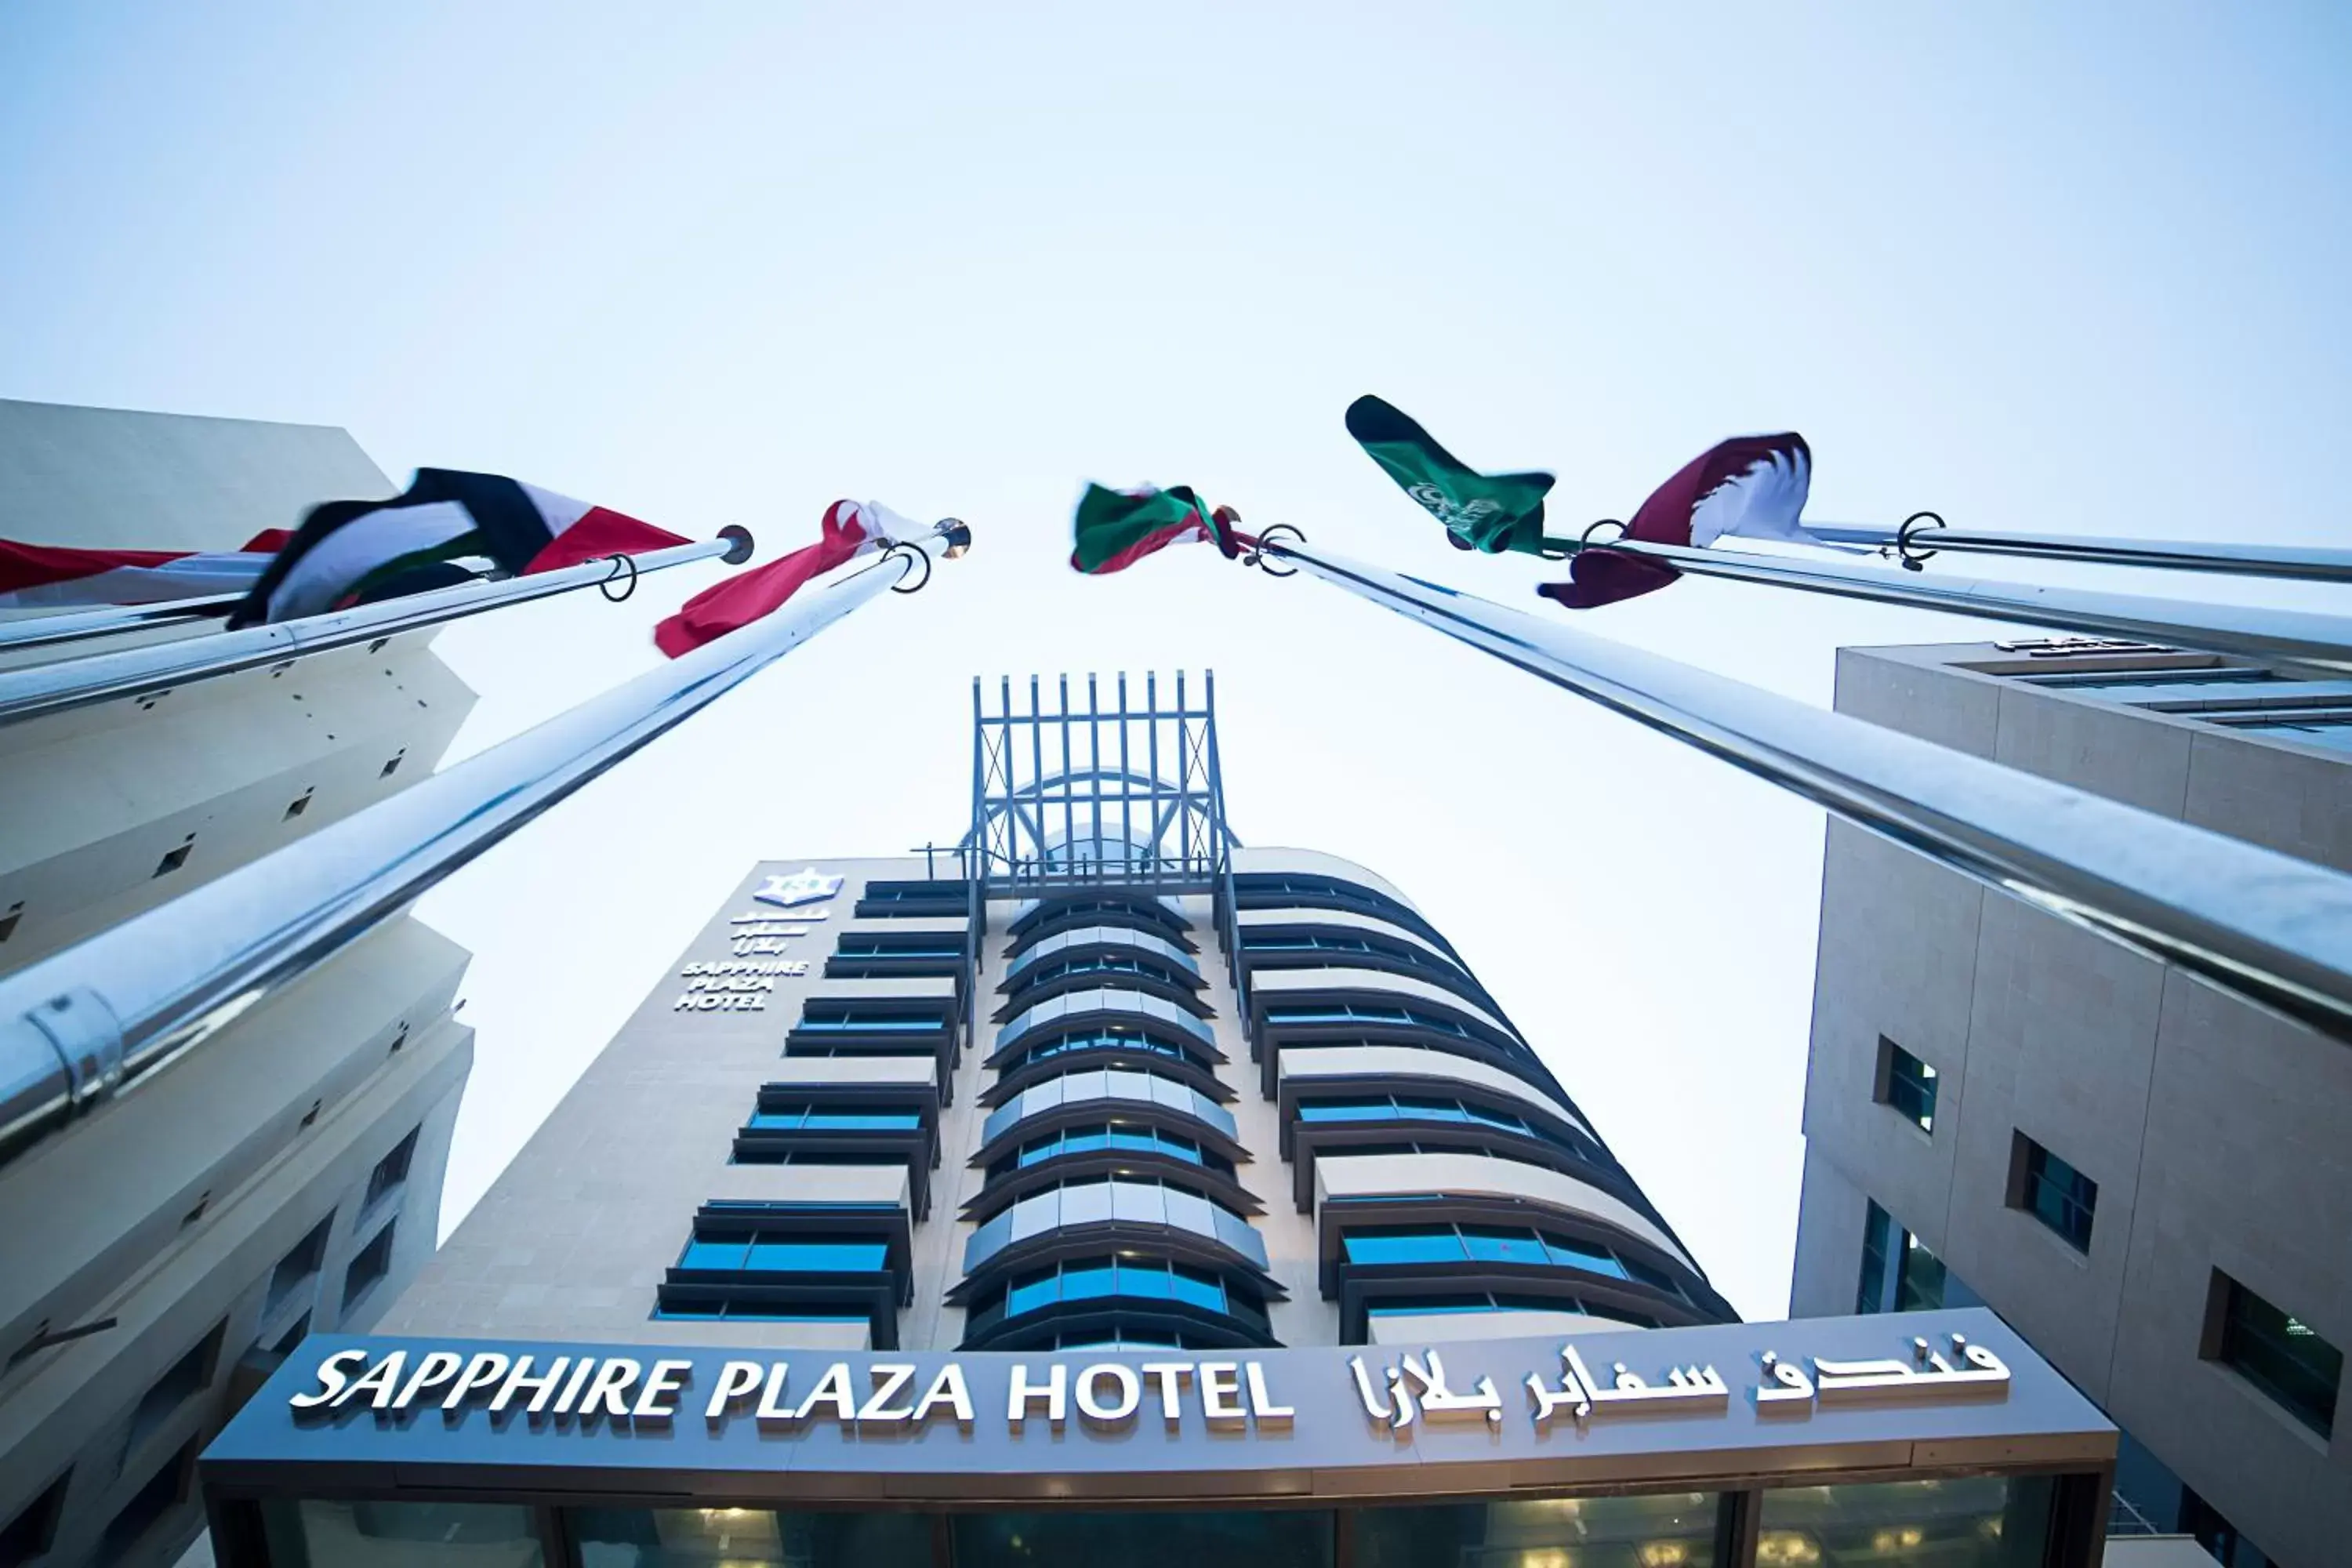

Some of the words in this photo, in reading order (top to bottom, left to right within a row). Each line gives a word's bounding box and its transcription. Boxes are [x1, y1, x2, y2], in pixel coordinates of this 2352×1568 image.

[674, 994, 765, 1011] HOTEL
[681, 961, 808, 976] SAPPHIRE
[688, 978, 773, 993] PLAZA
[289, 1350, 692, 1416] SAPPHIRE
[706, 1361, 974, 1421] PLAZA
[1008, 1362, 1294, 1421] HOTEL
[1350, 1349, 1501, 1428] بلازا
[1527, 1344, 1729, 1420] سفاير
[1756, 1333, 2011, 1401] فندق
